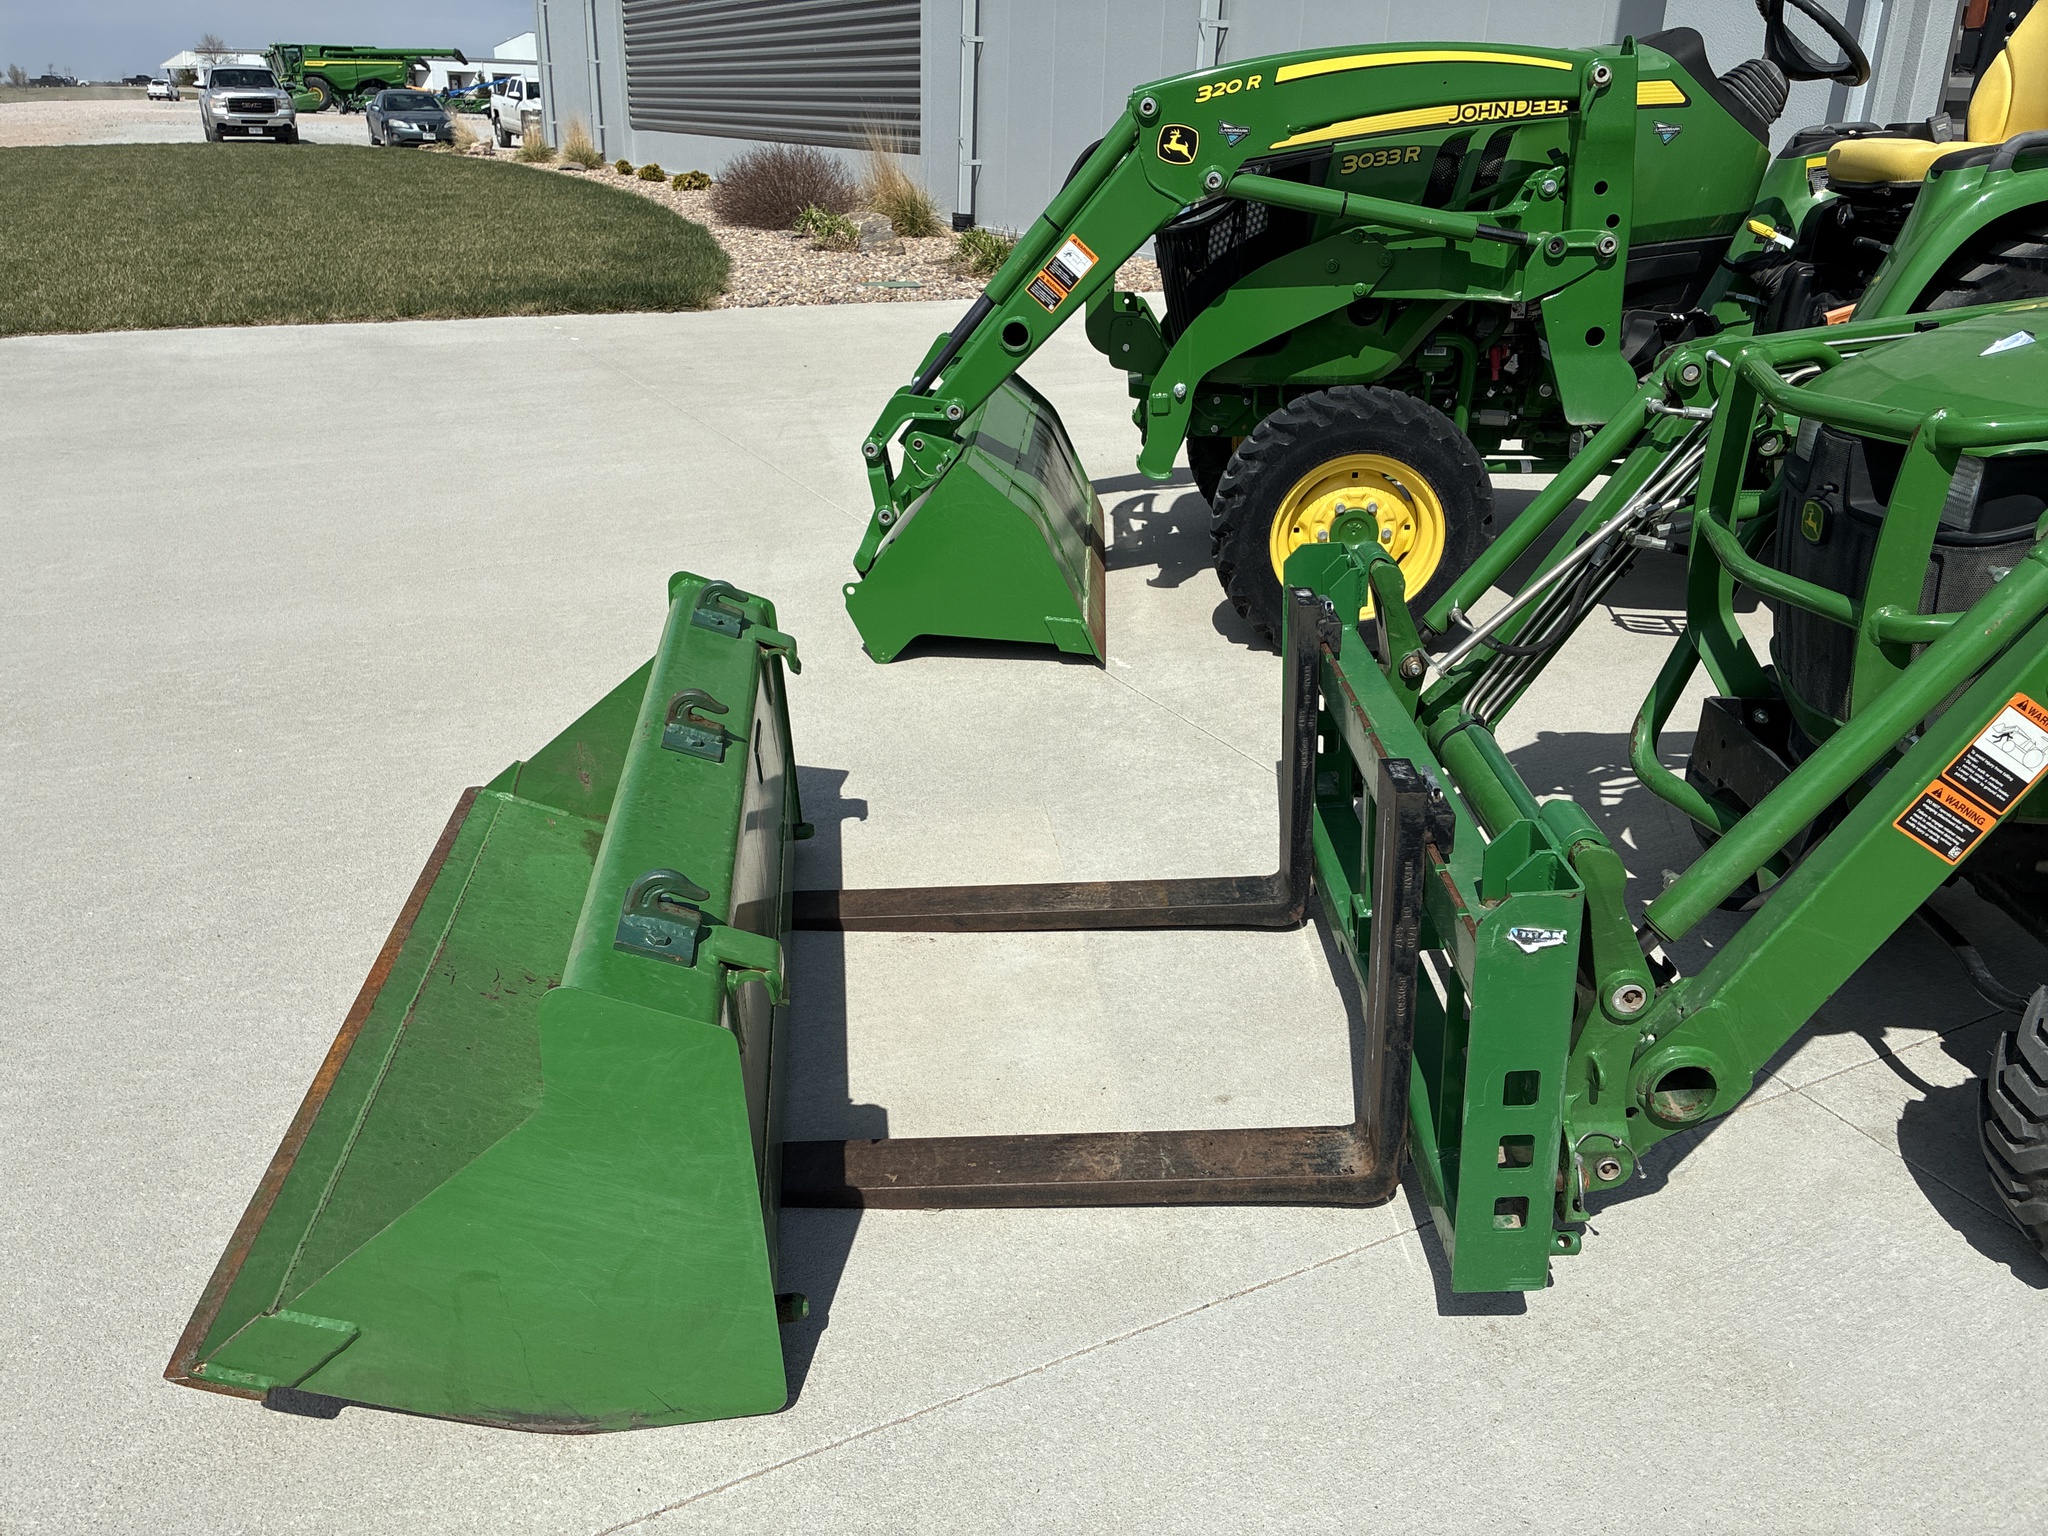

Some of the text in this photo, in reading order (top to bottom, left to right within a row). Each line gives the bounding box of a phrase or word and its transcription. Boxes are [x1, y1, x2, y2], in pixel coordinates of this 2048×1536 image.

[1195, 75, 1262, 103] 320 R
[1448, 100, 1568, 122] JOHN DEER
[1340, 146, 1422, 174] 3033 R
[1077, 241, 1095, 260] WARNING
[1046, 278, 1064, 296] WARNING
[2028, 706, 2048, 727] WAR
[1944, 794, 1986, 826] WARNING
[1404, 859, 1413, 889] TITAN
